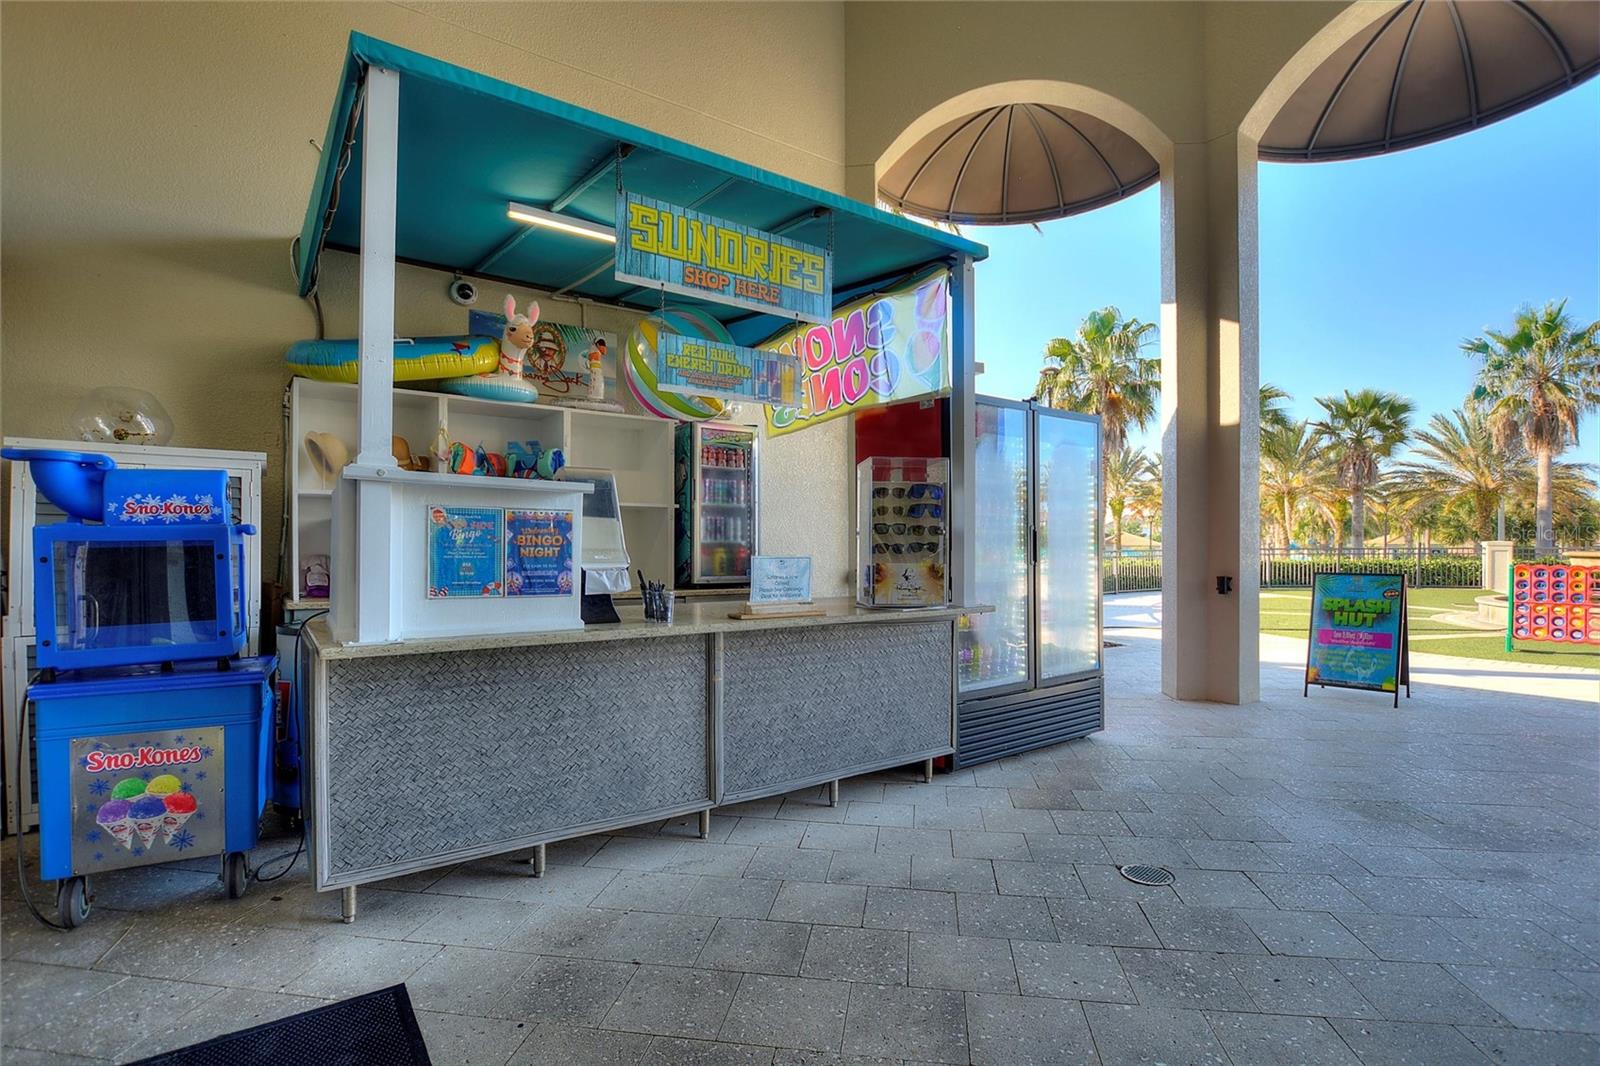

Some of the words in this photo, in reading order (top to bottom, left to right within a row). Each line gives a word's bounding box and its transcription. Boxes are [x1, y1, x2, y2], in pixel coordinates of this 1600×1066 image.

[628, 202, 826, 295] SUNDRIES
[683, 265, 730, 291] SHOP
[734, 278, 781, 304] HERE
[682, 343, 706, 359] RED
[709, 347, 737, 364] BULL
[667, 352, 714, 373] ENERGY
[717, 361, 752, 379] DRINK
[124, 501, 212, 517] Sno-Kones
[449, 528, 481, 543] Bingo
[517, 535, 564, 546] BINGO
[520, 547, 561, 558] NIGHT
[1323, 597, 1392, 615] SPLASH
[1333, 611, 1377, 628] HUT
[86, 745, 202, 773] Sno-Kones
